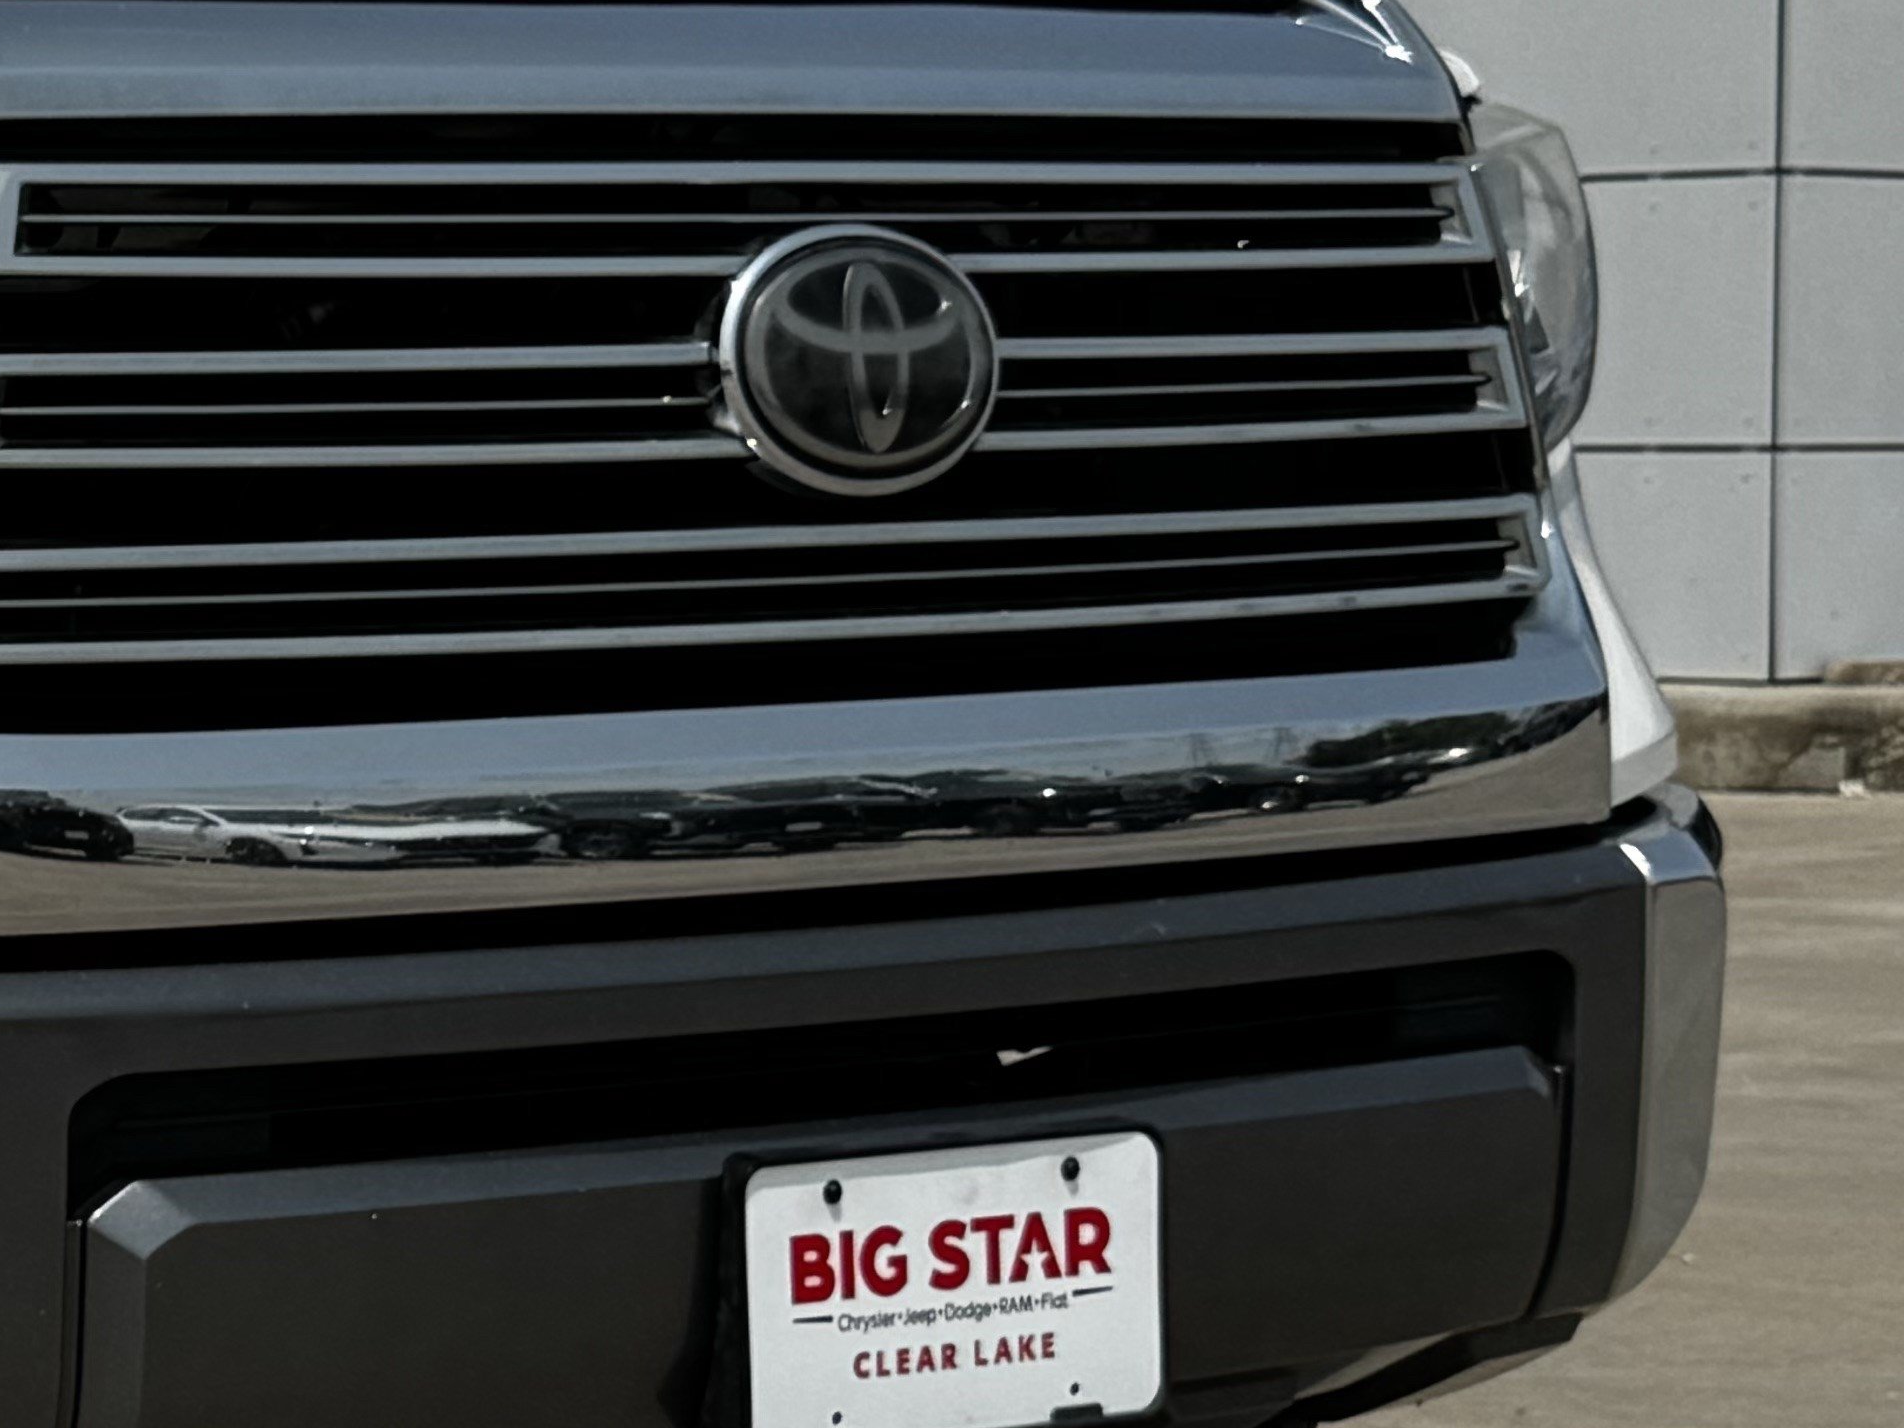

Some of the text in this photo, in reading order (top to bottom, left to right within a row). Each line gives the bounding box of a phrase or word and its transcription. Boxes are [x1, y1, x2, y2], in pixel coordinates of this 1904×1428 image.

[788, 1206, 1112, 1306] BIG STAR
[852, 1331, 1057, 1379] CLEAR LAKE
